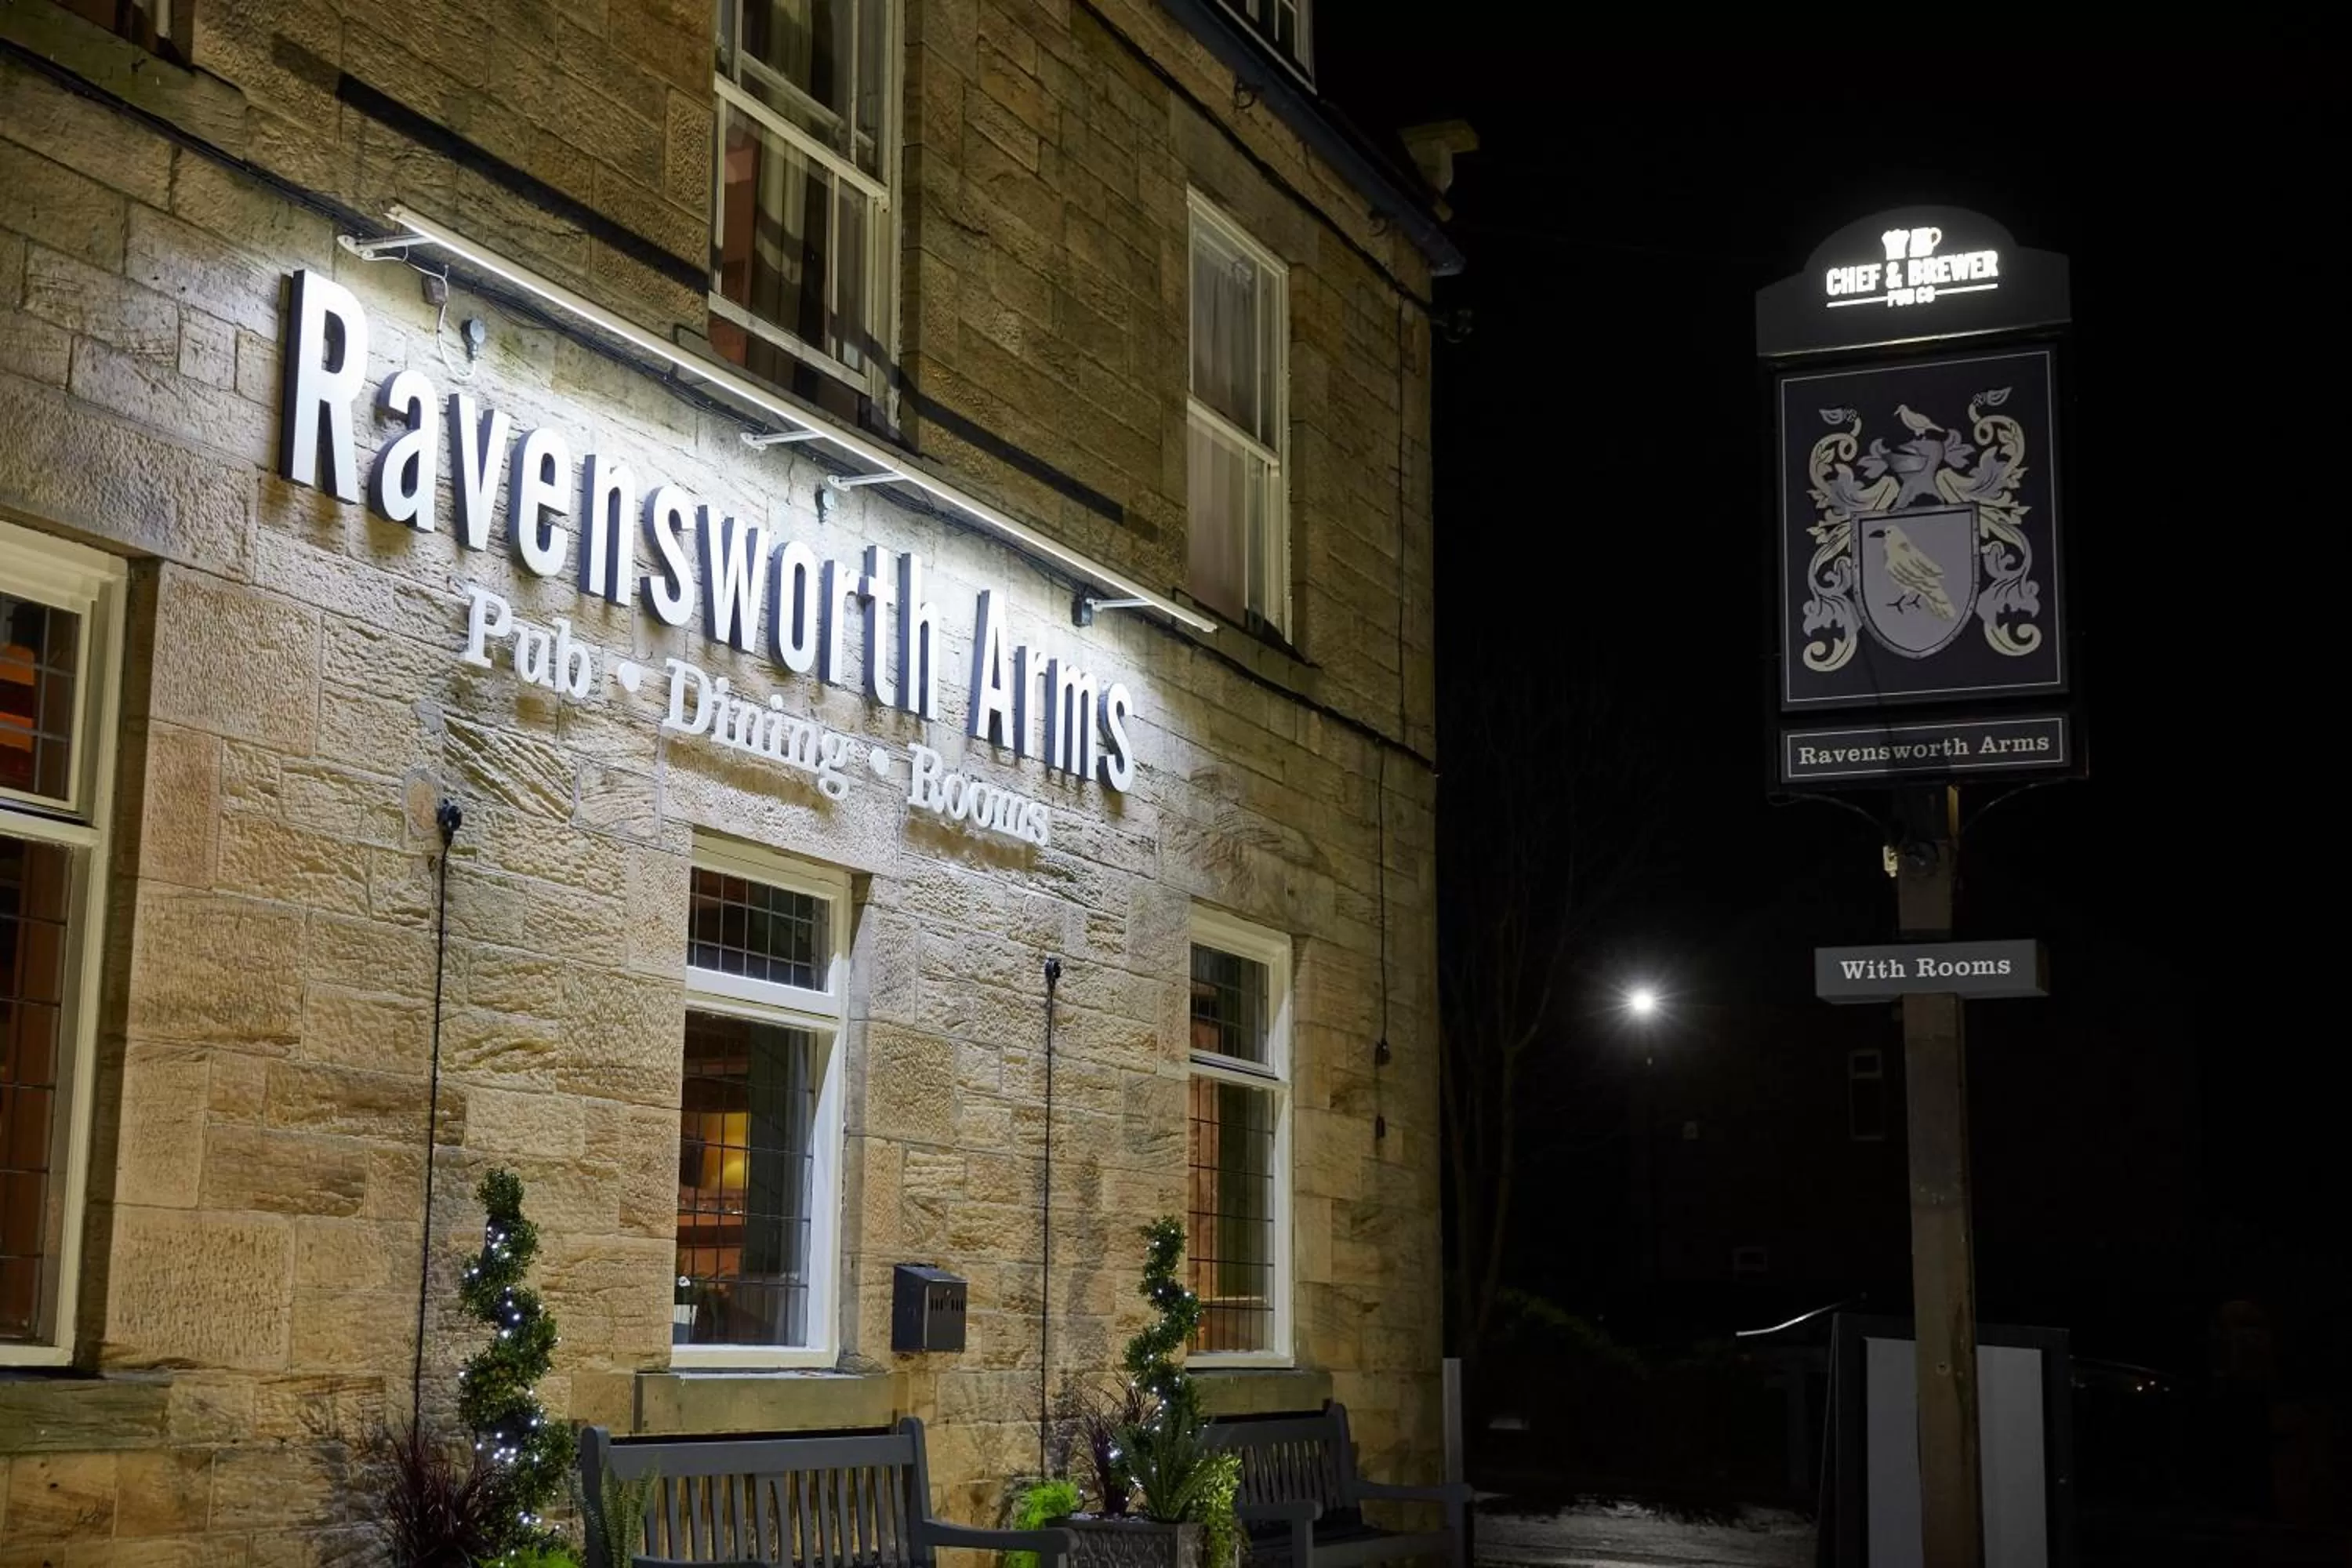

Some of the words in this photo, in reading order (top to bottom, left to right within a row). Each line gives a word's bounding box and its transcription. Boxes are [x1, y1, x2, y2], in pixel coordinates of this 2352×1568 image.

[1826, 264, 1882, 296] CHEF
[1886, 261, 1903, 289] &
[1908, 250, 1998, 285] BREWER
[283, 269, 938, 721] Ravensworth
[969, 590, 1134, 793] Arms
[463, 584, 591, 699] Pub
[662, 658, 857, 800] Dining
[906, 743, 1051, 847] Rooms
[1799, 738, 1969, 764] Ravensworth
[1980, 736, 2049, 753] Arms
[1841, 959, 1906, 979] With
[1916, 958, 2011, 978] Rooms
